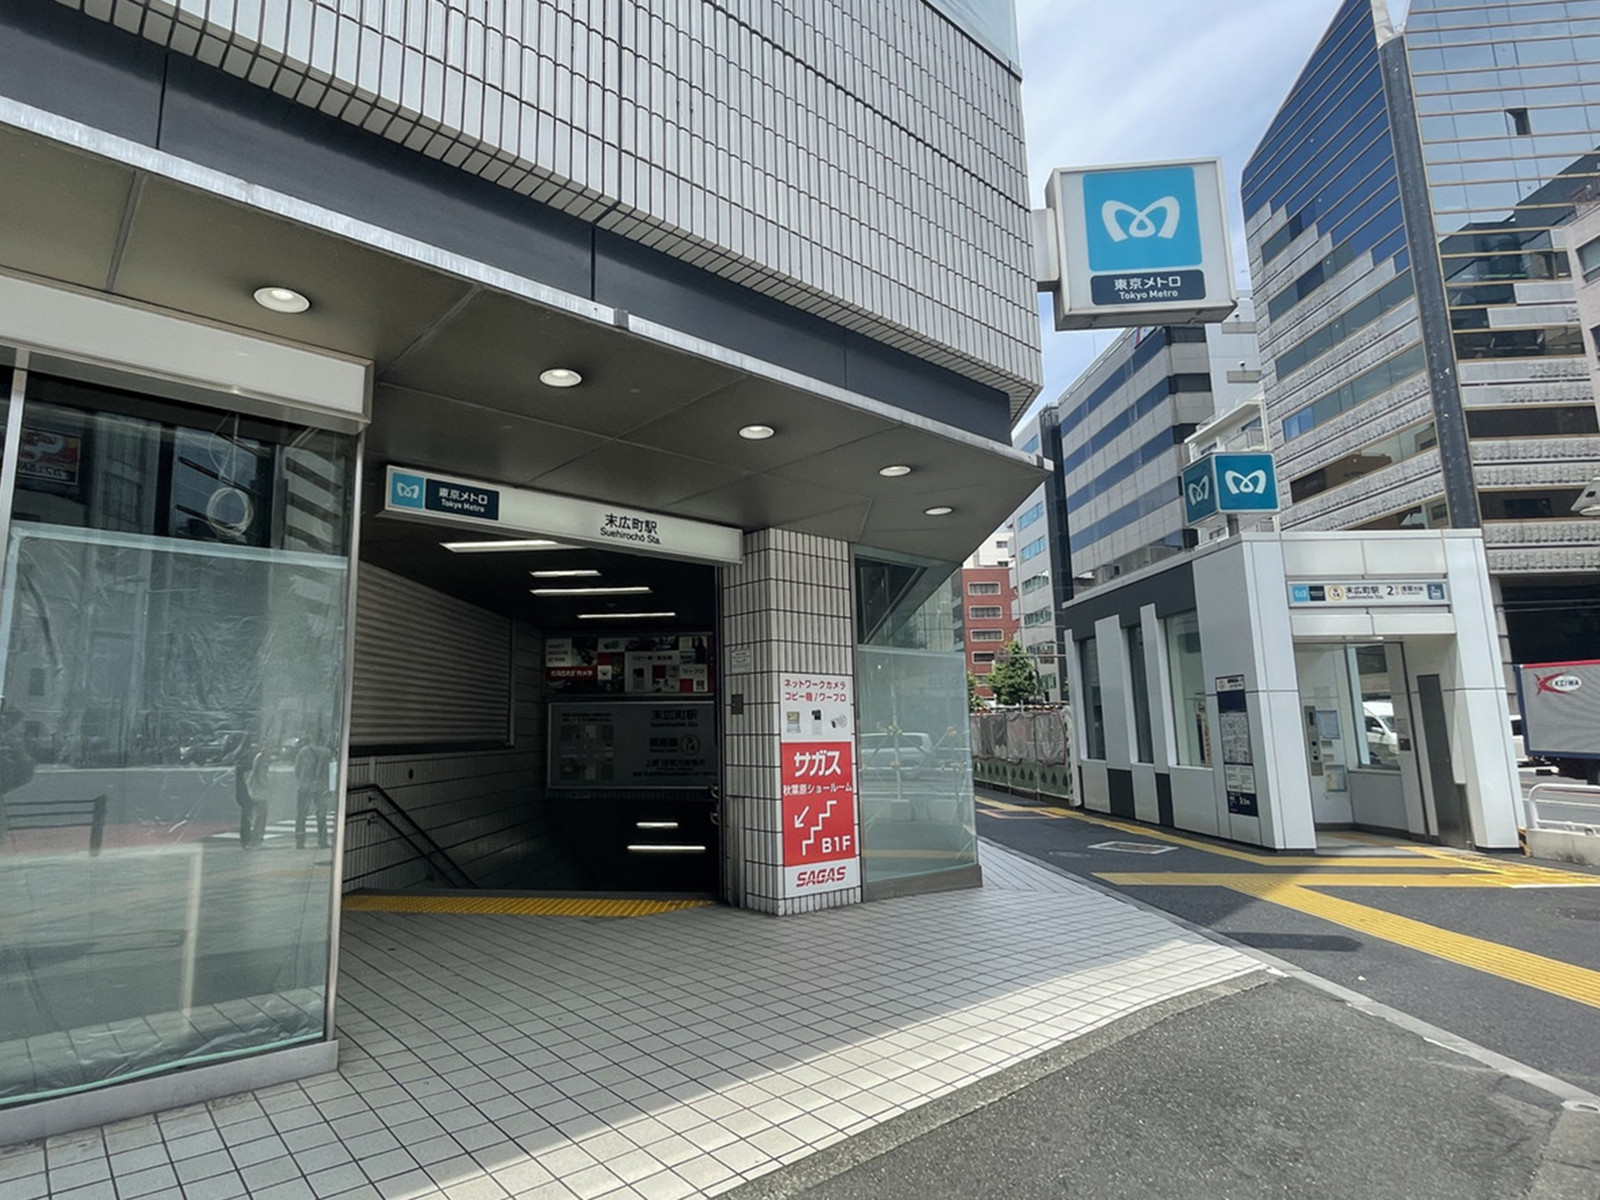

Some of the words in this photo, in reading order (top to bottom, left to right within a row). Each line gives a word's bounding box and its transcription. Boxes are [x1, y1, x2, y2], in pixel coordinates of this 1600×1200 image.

[1114, 276, 1181, 290] 東京メトロ
[1119, 291, 1148, 300] Tokyo
[1149, 290, 1178, 298] Metro
[439, 487, 488, 505] 東京メトロ
[441, 498, 462, 510] Tokyo
[463, 502, 485, 513] Metro
[605, 513, 657, 535] 末広町駅
[1387, 585, 1394, 595] 2
[785, 679, 846, 690] ネットワークカメラ
[794, 750, 841, 777] サガス
[822, 836, 851, 853] B1F
[796, 866, 846, 887] SAGAS
